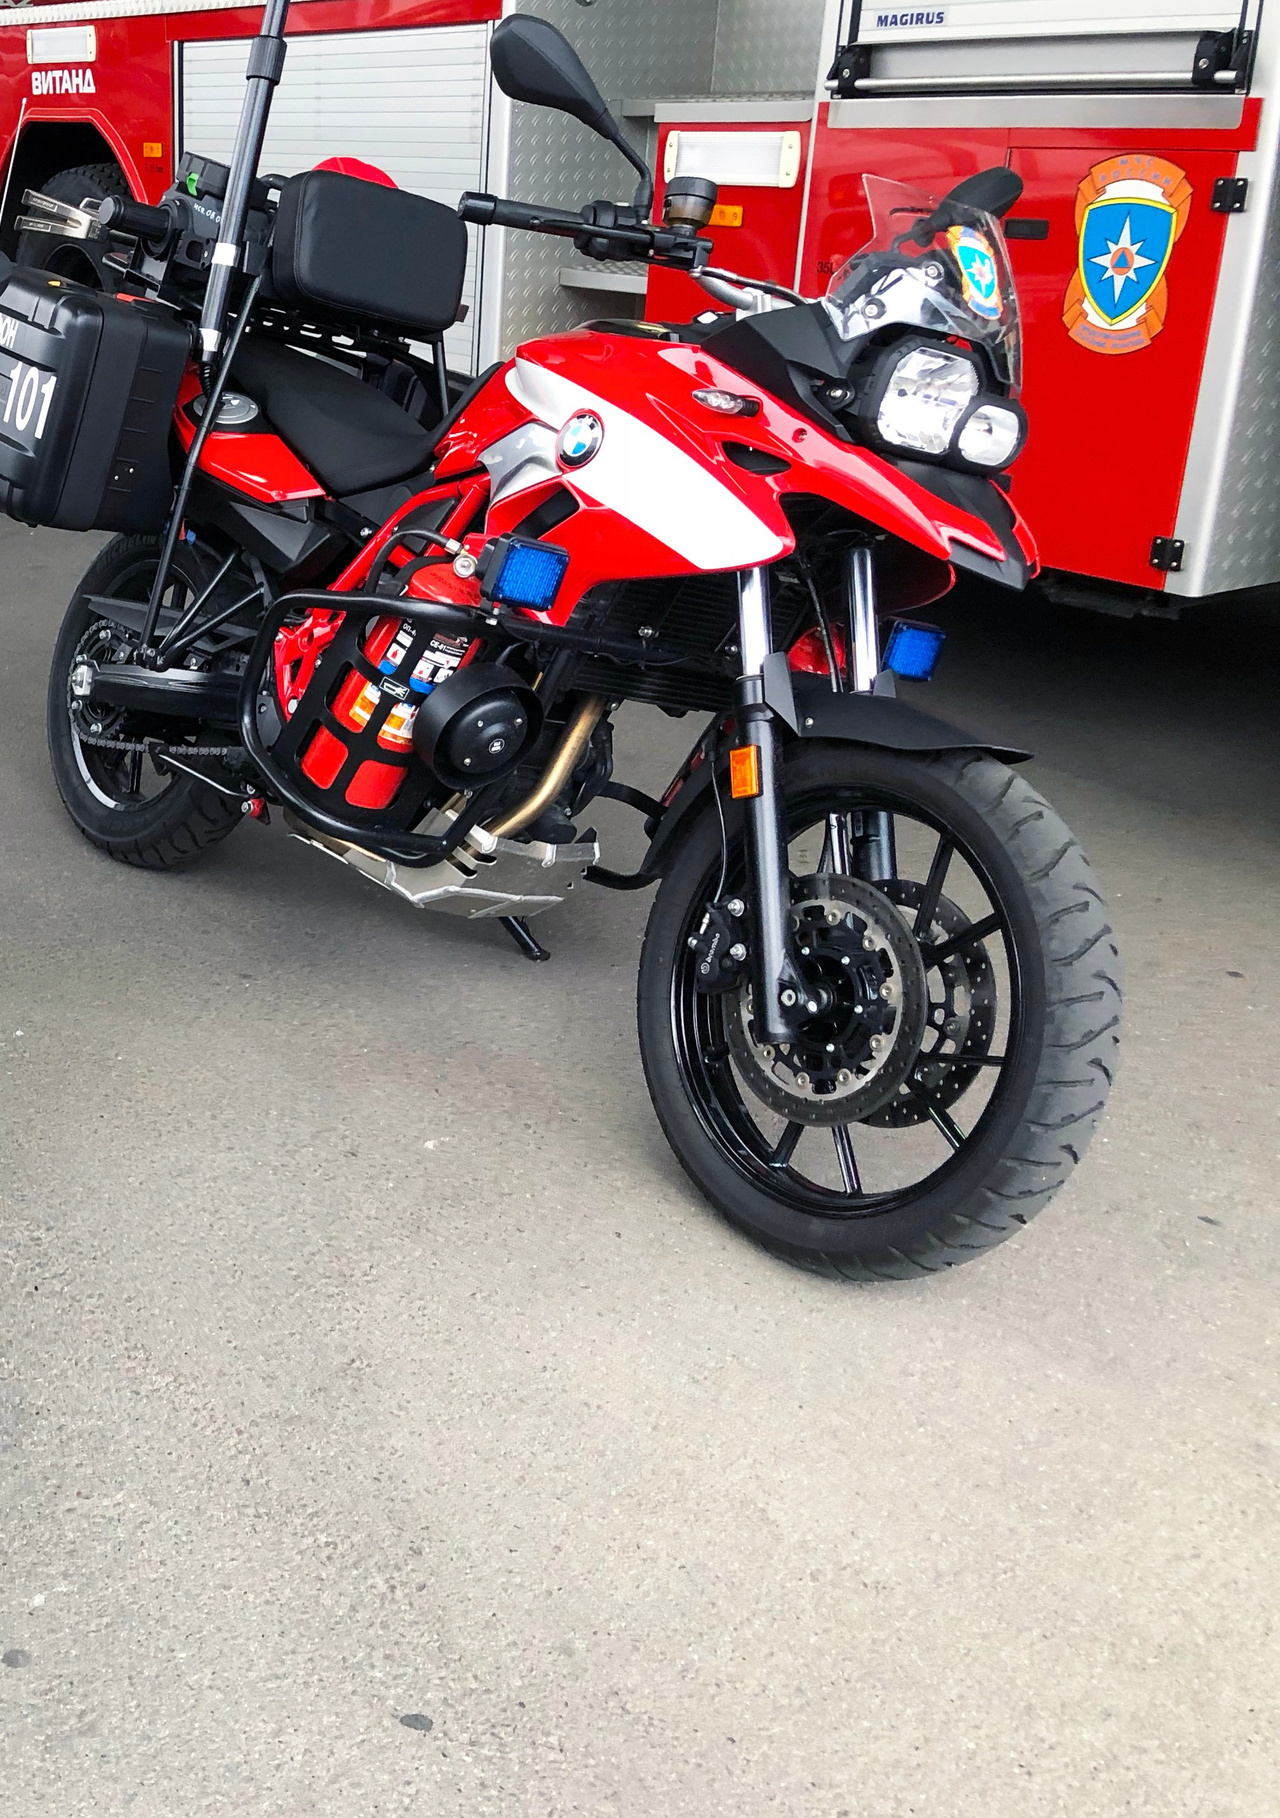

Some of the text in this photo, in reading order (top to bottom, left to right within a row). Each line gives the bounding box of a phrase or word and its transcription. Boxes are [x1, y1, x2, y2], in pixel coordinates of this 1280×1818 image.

[876, 11, 945, 28] MAGIRUS
[31, 68, 96, 95] ВИТАНД
[3, 360, 57, 440] 101
[705, 933, 721, 963] brembo
